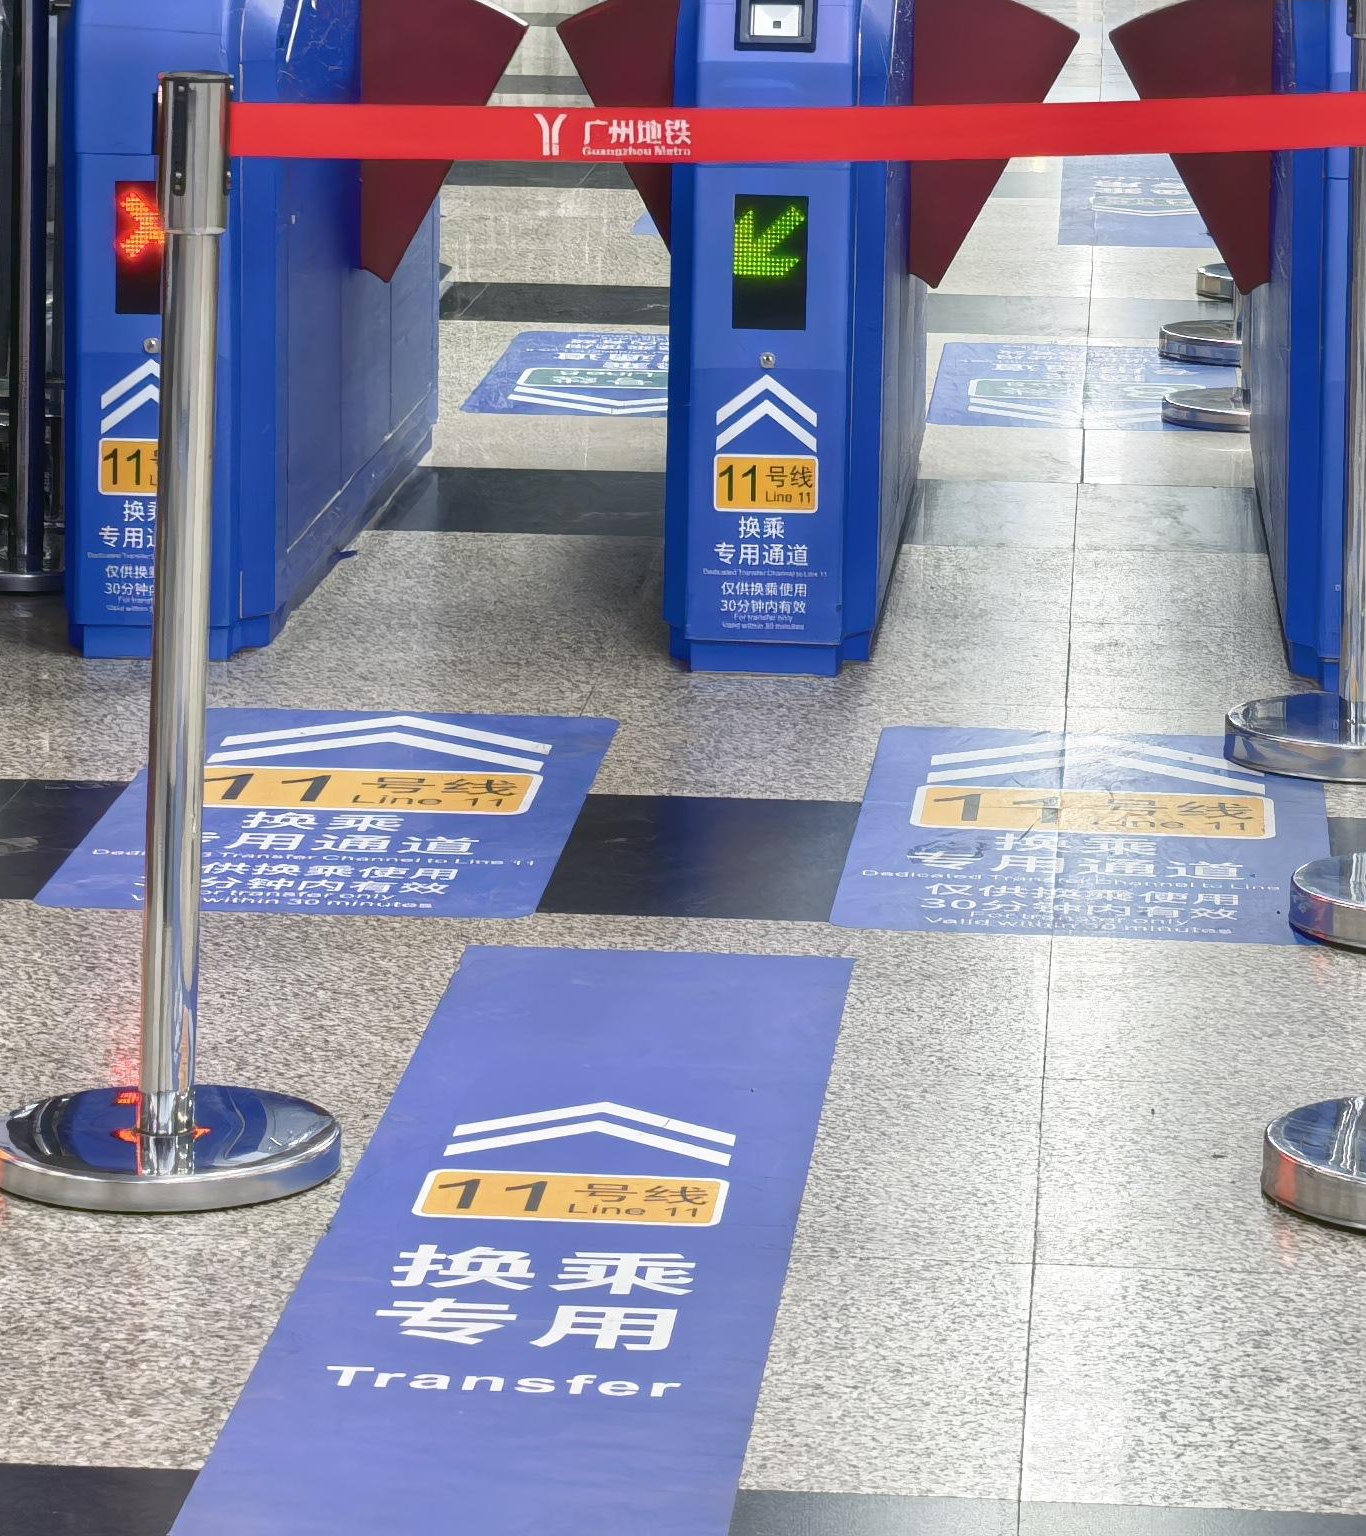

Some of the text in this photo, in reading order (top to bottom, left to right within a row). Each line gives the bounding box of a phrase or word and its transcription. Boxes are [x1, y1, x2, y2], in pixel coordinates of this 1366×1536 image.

[583, 119, 692, 146] 广州地铁
[582, 146, 691, 158] Guangzhou Metro
[102, 447, 141, 486] 11
[766, 465, 813, 490] 号线
[717, 463, 758, 503] 11
[765, 490, 812, 505] Line 11
[738, 515, 786, 539] 换乘
[713, 542, 809, 567] 专用通道
[721, 581, 807, 597] 仅供换乘使用
[720, 599, 806, 614] 30分钟内有效
[203, 774, 333, 803] 11
[361, 775, 519, 799] 号线
[351, 793, 505, 809] Line 11
[241, 810, 405, 834] 换乘
[202, 831, 481, 856] 用通道
[993, 831, 1159, 857] 换乘
[437, 1178, 552, 1213] 11
[573, 1181, 709, 1207] 号线
[566, 1201, 699, 1219] Line 11
[389, 1243, 697, 1296] 换乘
[374, 1297, 679, 1352] 专用
[326, 1364, 683, 1399] Transfer
